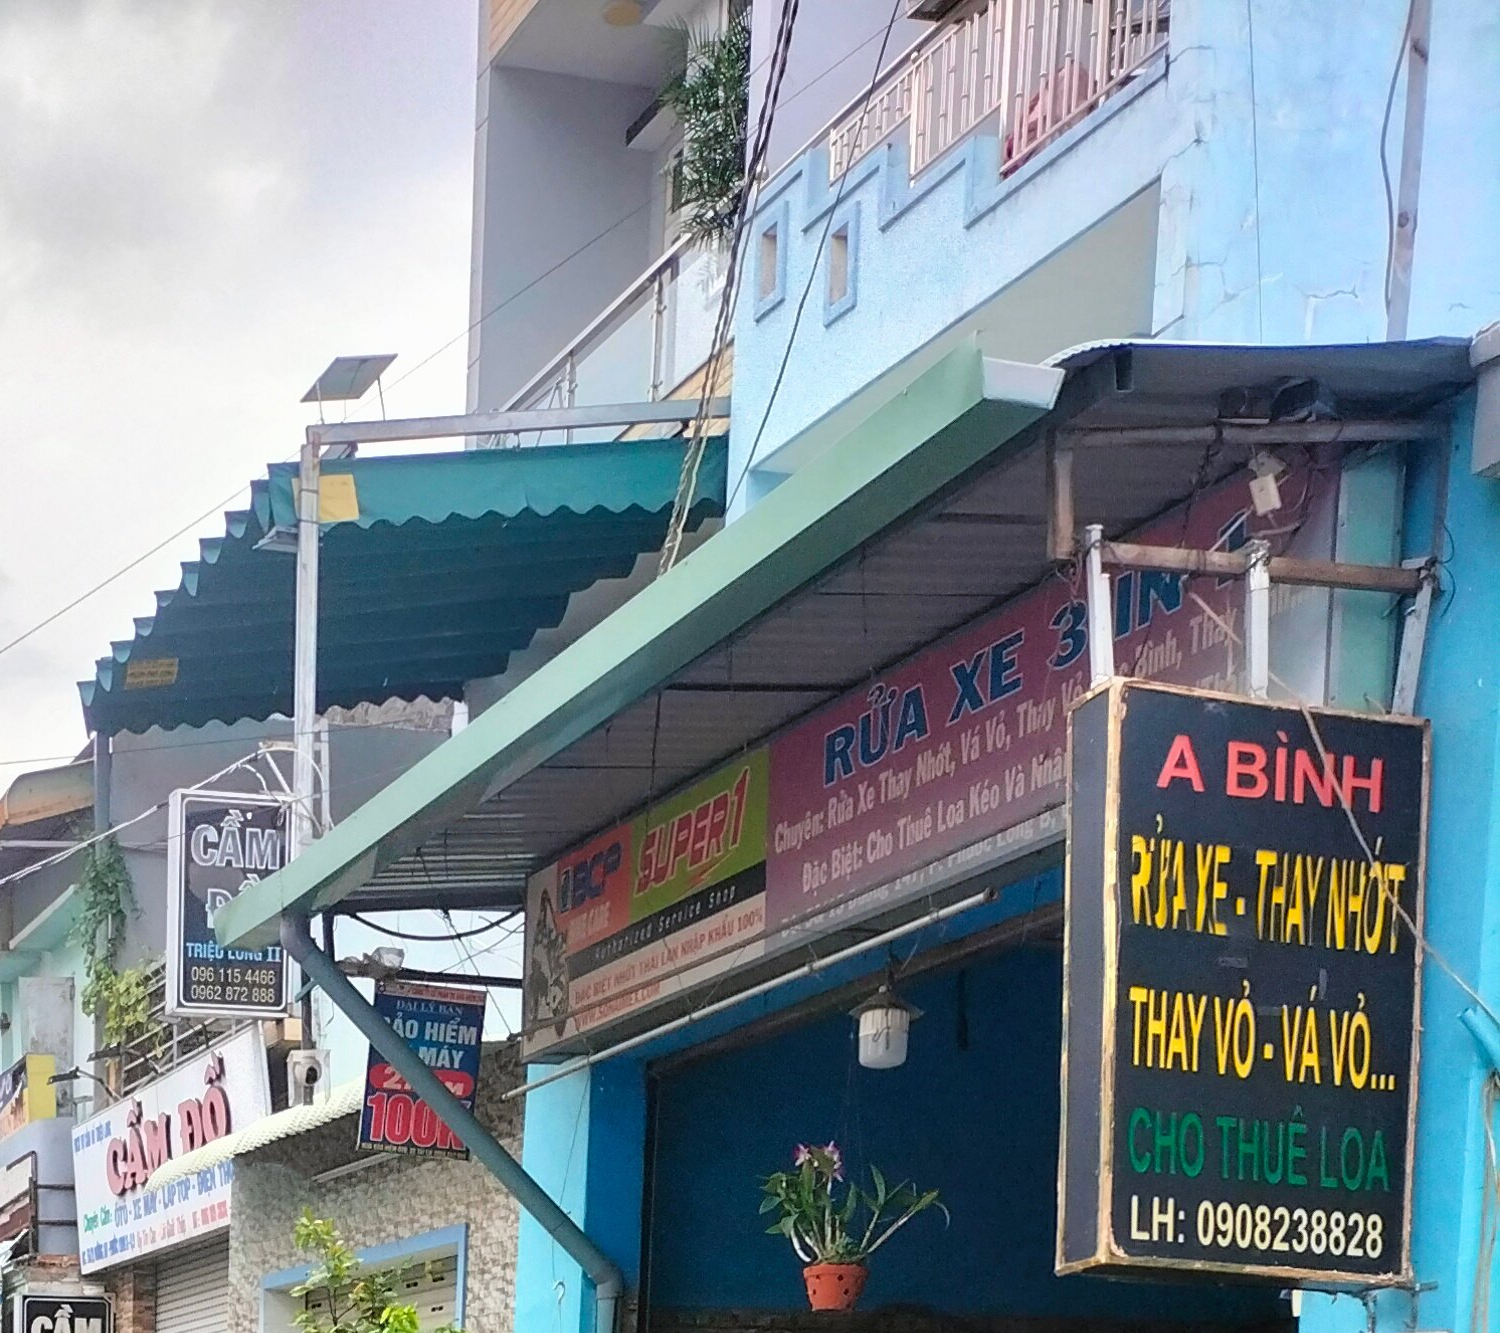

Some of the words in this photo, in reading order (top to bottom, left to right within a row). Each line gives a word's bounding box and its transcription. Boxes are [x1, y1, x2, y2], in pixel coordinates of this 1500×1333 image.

[822, 682, 930, 788] RỬA
[946, 628, 1025, 726] XE
[1046, 599, 1089, 671] 3
[857, 779, 875, 815] Xe
[879, 767, 912, 805] Thay
[961, 724, 980, 765] Vá
[1016, 697, 1057, 739] Thay
[1156, 734, 1204, 792] A
[1226, 730, 1384, 813] BÌNH
[190, 809, 280, 869] CẦM
[866, 829, 893, 863] Cho
[898, 809, 933, 850] Thuê
[937, 799, 965, 832] Loa
[969, 778, 999, 818] Kéo
[1005, 764, 1025, 802] Và
[658, 902, 701, 935] Service
[1131, 813, 1191, 930] RỬA
[1195, 842, 1231, 936] XE
[1255, 848, 1324, 947] THAY
[1326, 835, 1407, 955] NHỚT
[191, 966, 215, 983] 096
[219, 968, 241, 984] 115
[244, 969, 276, 986] 4466
[191, 985, 222, 1000] 0962
[225, 986, 248, 1001] 872
[252, 988, 276, 1002] 888
[418, 1045, 465, 1070] MÁY
[425, 1017, 478, 1046] HIỂM
[1129, 986, 1207, 1073] THAY
[1214, 979, 1256, 1079] VỎ
[1282, 985, 1321, 1084] VÁ
[107, 1096, 173, 1196] CẦM
[178, 1050, 233, 1154] ĐỒ
[1127, 1106, 1205, 1178] CHO
[1215, 1104, 1308, 1185] THUÊ
[1319, 1125, 1391, 1192] LOA
[1130, 1194, 1185, 1243] LH:
[1197, 1199, 1384, 1259] 0908238828
